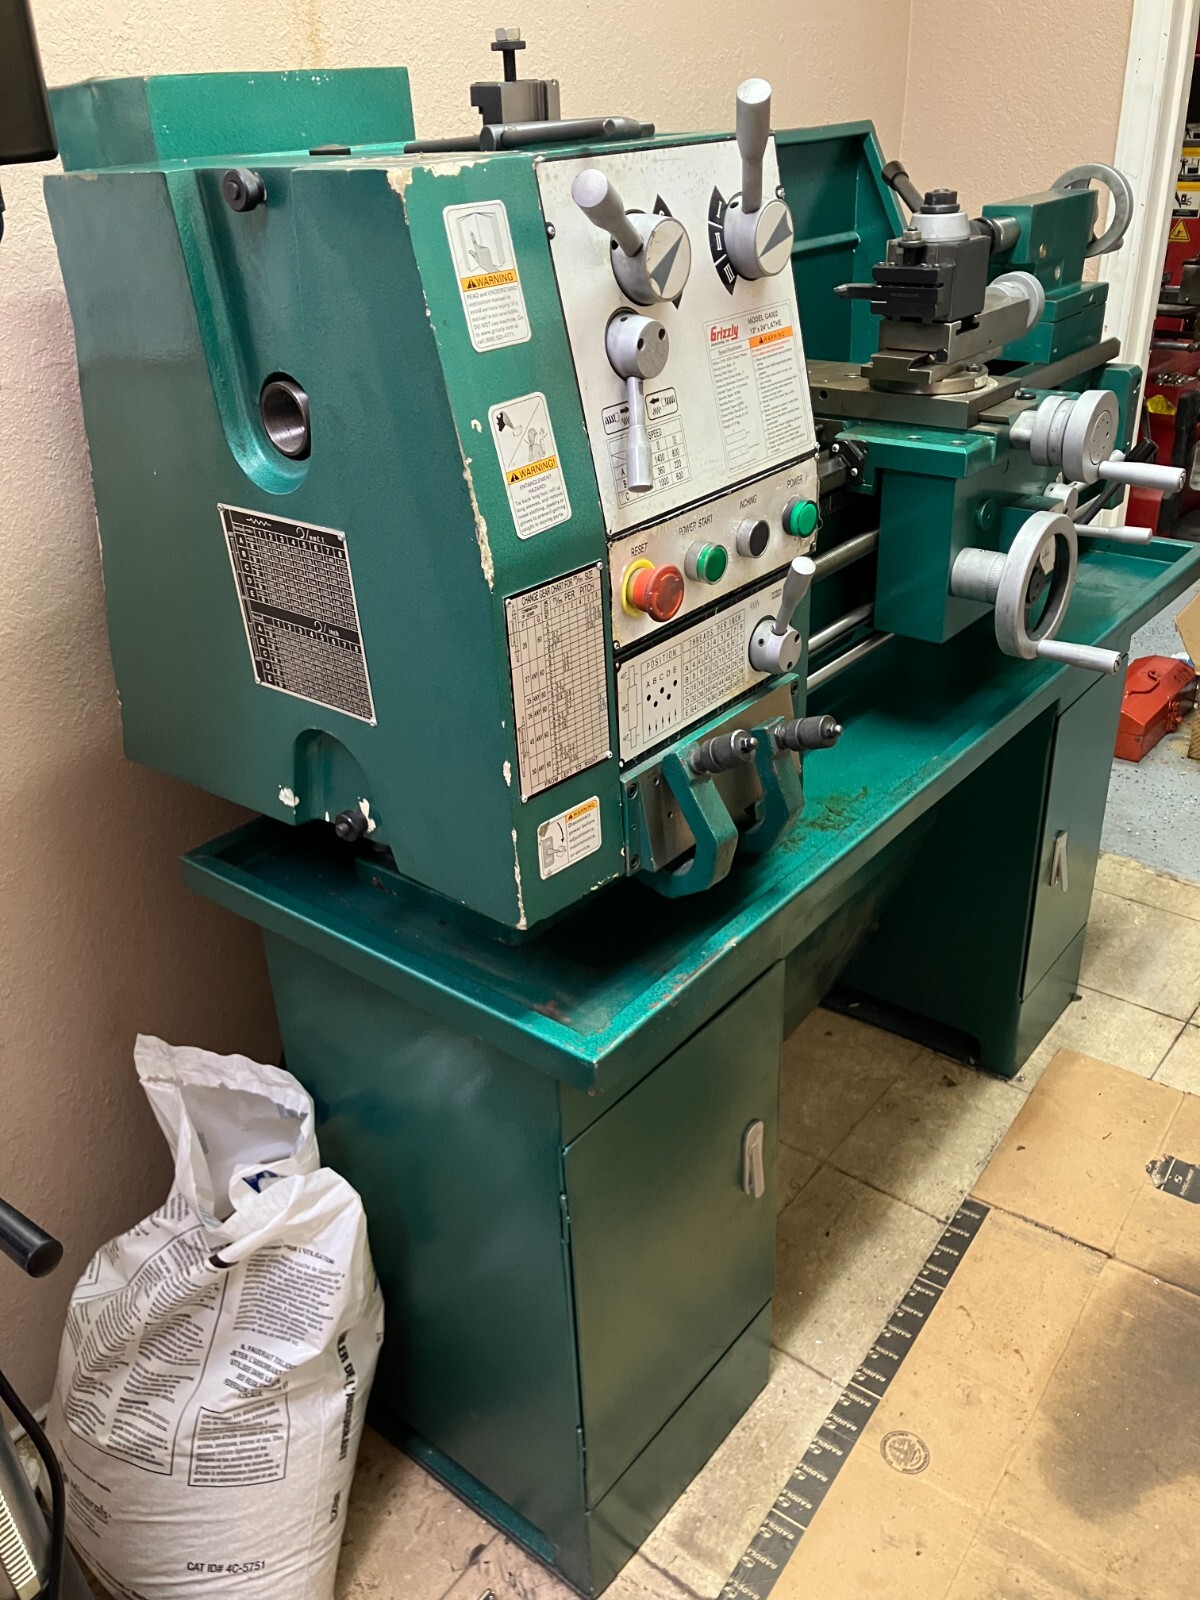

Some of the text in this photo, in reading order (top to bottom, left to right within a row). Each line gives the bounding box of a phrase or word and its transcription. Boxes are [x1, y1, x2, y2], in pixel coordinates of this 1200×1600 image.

[475, 272, 514, 287] WARNING
[747, 314, 764, 325] MODEL
[767, 319, 782, 330] LATHE
[710, 323, 739, 342] Grizzly
[763, 330, 785, 342] WARNING
[647, 428, 662, 440] SPEED
[519, 457, 556, 480] WARNING!
[621, 467, 625, 476] A
[786, 474, 803, 489] POWER
[625, 492, 630, 501] C
[678, 513, 714, 536] POWER START
[630, 542, 648, 557] RESET
[521, 591, 539, 606] CHANGE
[540, 587, 550, 599] GEAR
[551, 582, 564, 594] CHART
[564, 578, 573, 589] FOR
[584, 570, 594, 581] SIZE
[564, 582, 594, 601] PER PITCH
[689, 613, 742, 646] THREADS PER INCH
[646, 649, 677, 671] POSITION
[673, 666, 677, 674] E
[544, 776, 559, 786] FROM
[561, 769, 573, 779] LEFT
[585, 756, 599, 766] RIGHT
[573, 802, 595, 817] WARNING
[567, 812, 592, 829] Disconnect
[582, 819, 595, 828] before
[186, 1560, 266, 1574] CAT ID# 4C-5751
